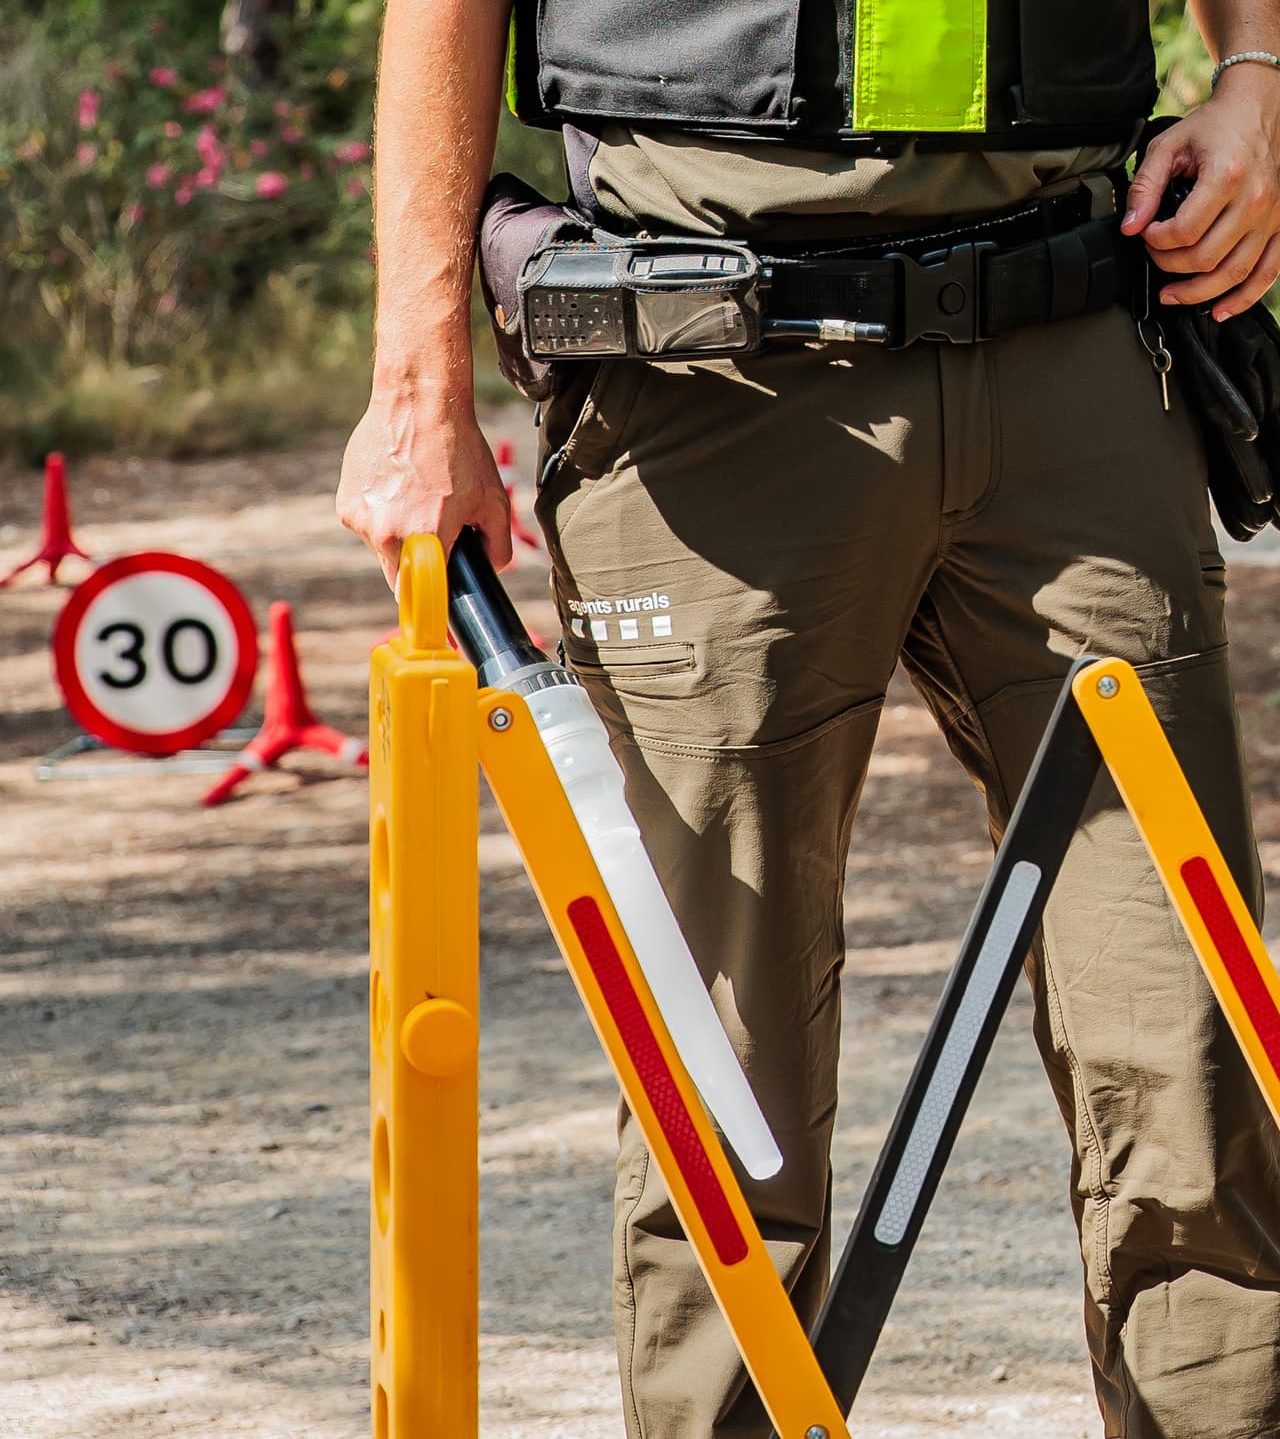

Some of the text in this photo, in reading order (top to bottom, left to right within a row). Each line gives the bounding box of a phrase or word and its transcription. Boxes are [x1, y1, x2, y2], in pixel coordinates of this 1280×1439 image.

[567, 592, 670, 616] agents rurals
[97, 619, 217, 689] 30
